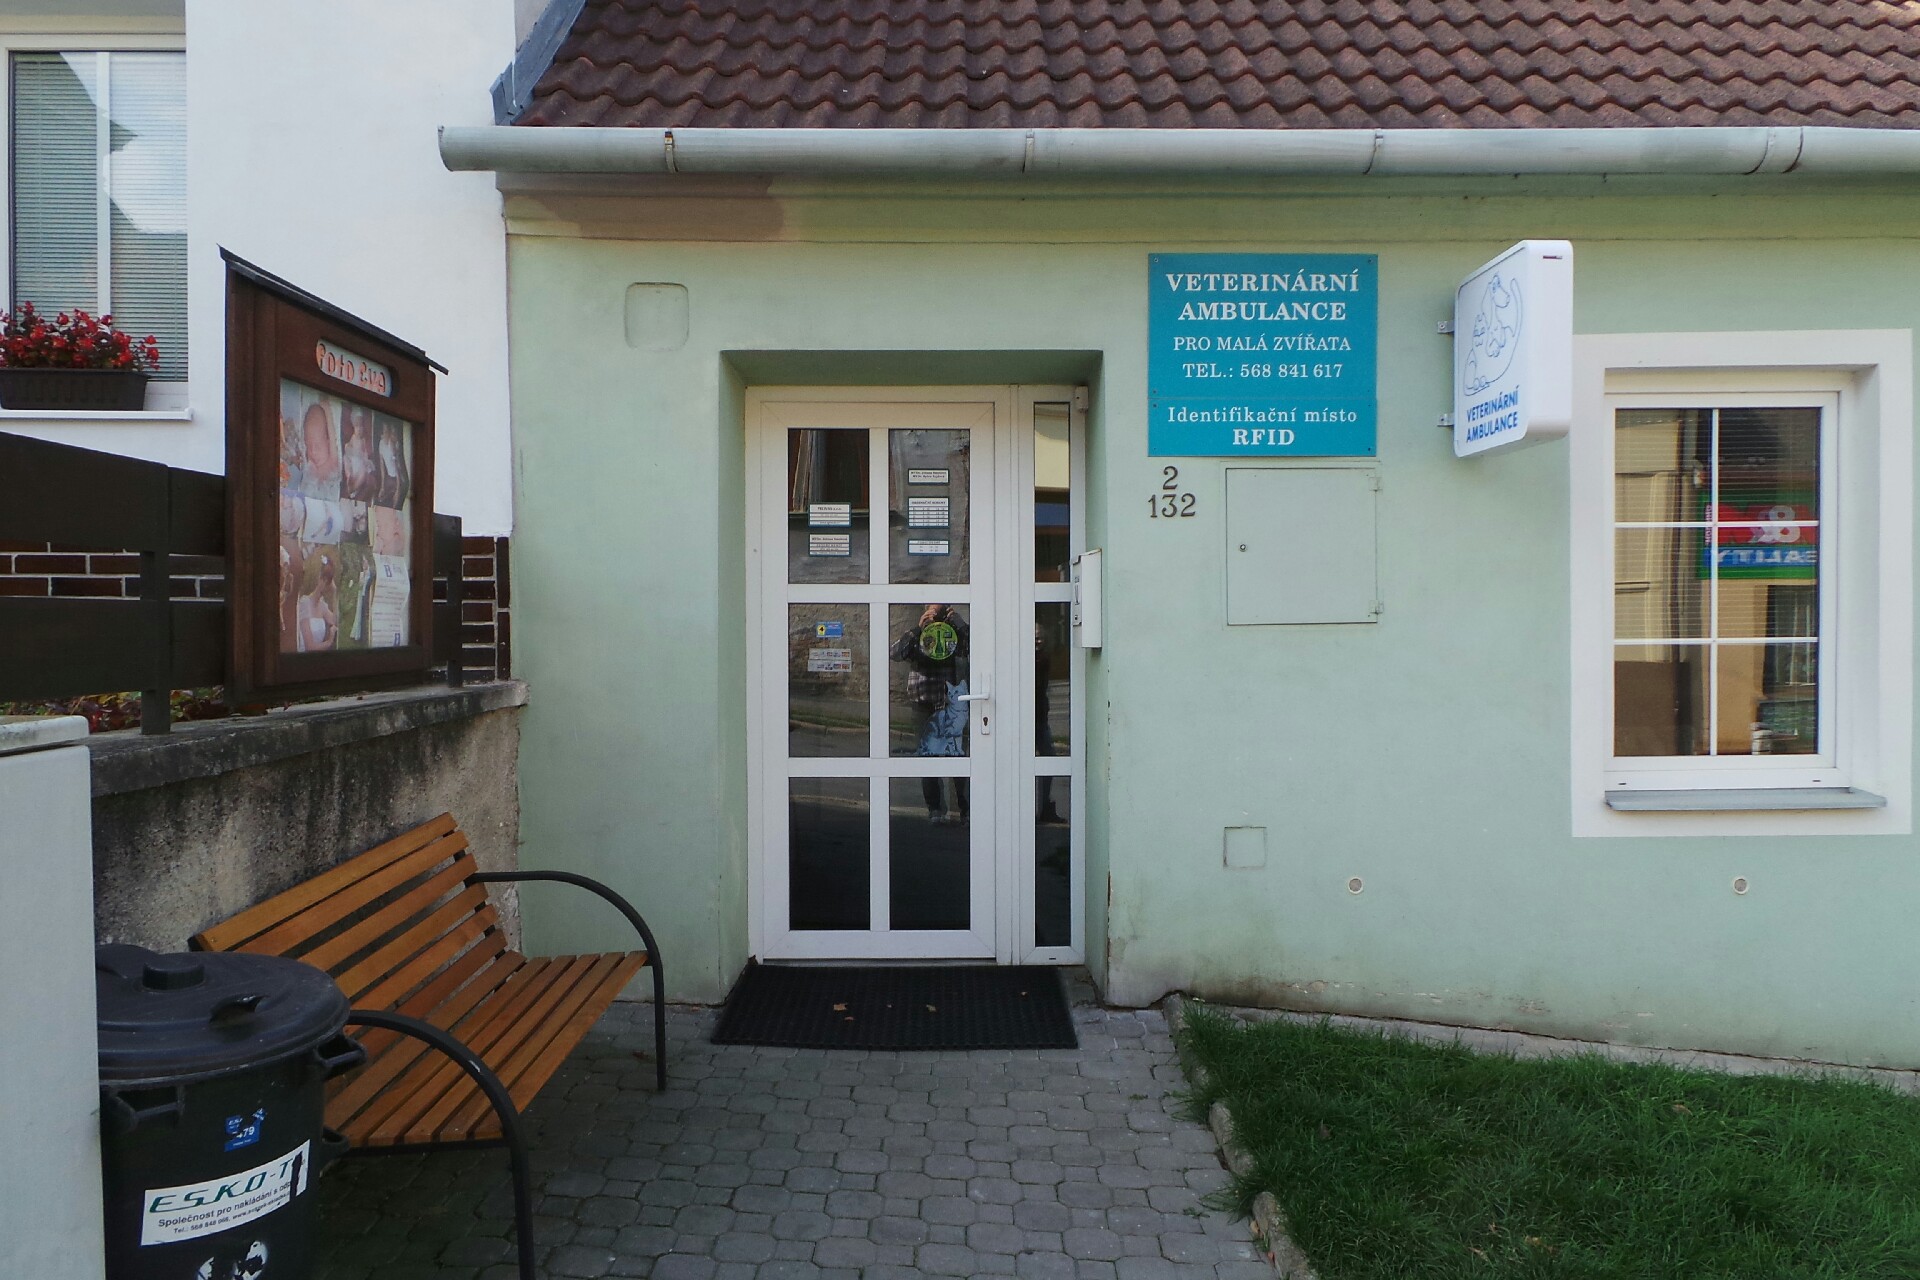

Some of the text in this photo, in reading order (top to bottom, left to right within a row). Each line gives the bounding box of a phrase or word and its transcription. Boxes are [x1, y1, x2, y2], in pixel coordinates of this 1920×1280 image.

[1165, 268, 1360, 292] VETERINÁRNÍ
[1177, 301, 1347, 321] AMBULANCE
[1173, 333, 1352, 351] PRO MALÁ ZVÍŘATA
[1182, 363, 1343, 378] TEL.: 568 841 617
[1167, 406, 1358, 423] Identifikační místo
[1466, 385, 1519, 422] VETERINÁRNÍ
[1232, 428, 1296, 446] RFID
[1466, 411, 1518, 443] AMBULANCE
[1162, 466, 1179, 490] 2
[1148, 492, 1196, 518] 132
[158, 1210, 215, 1228] Společnost
[217, 1205, 232, 1217] pro
